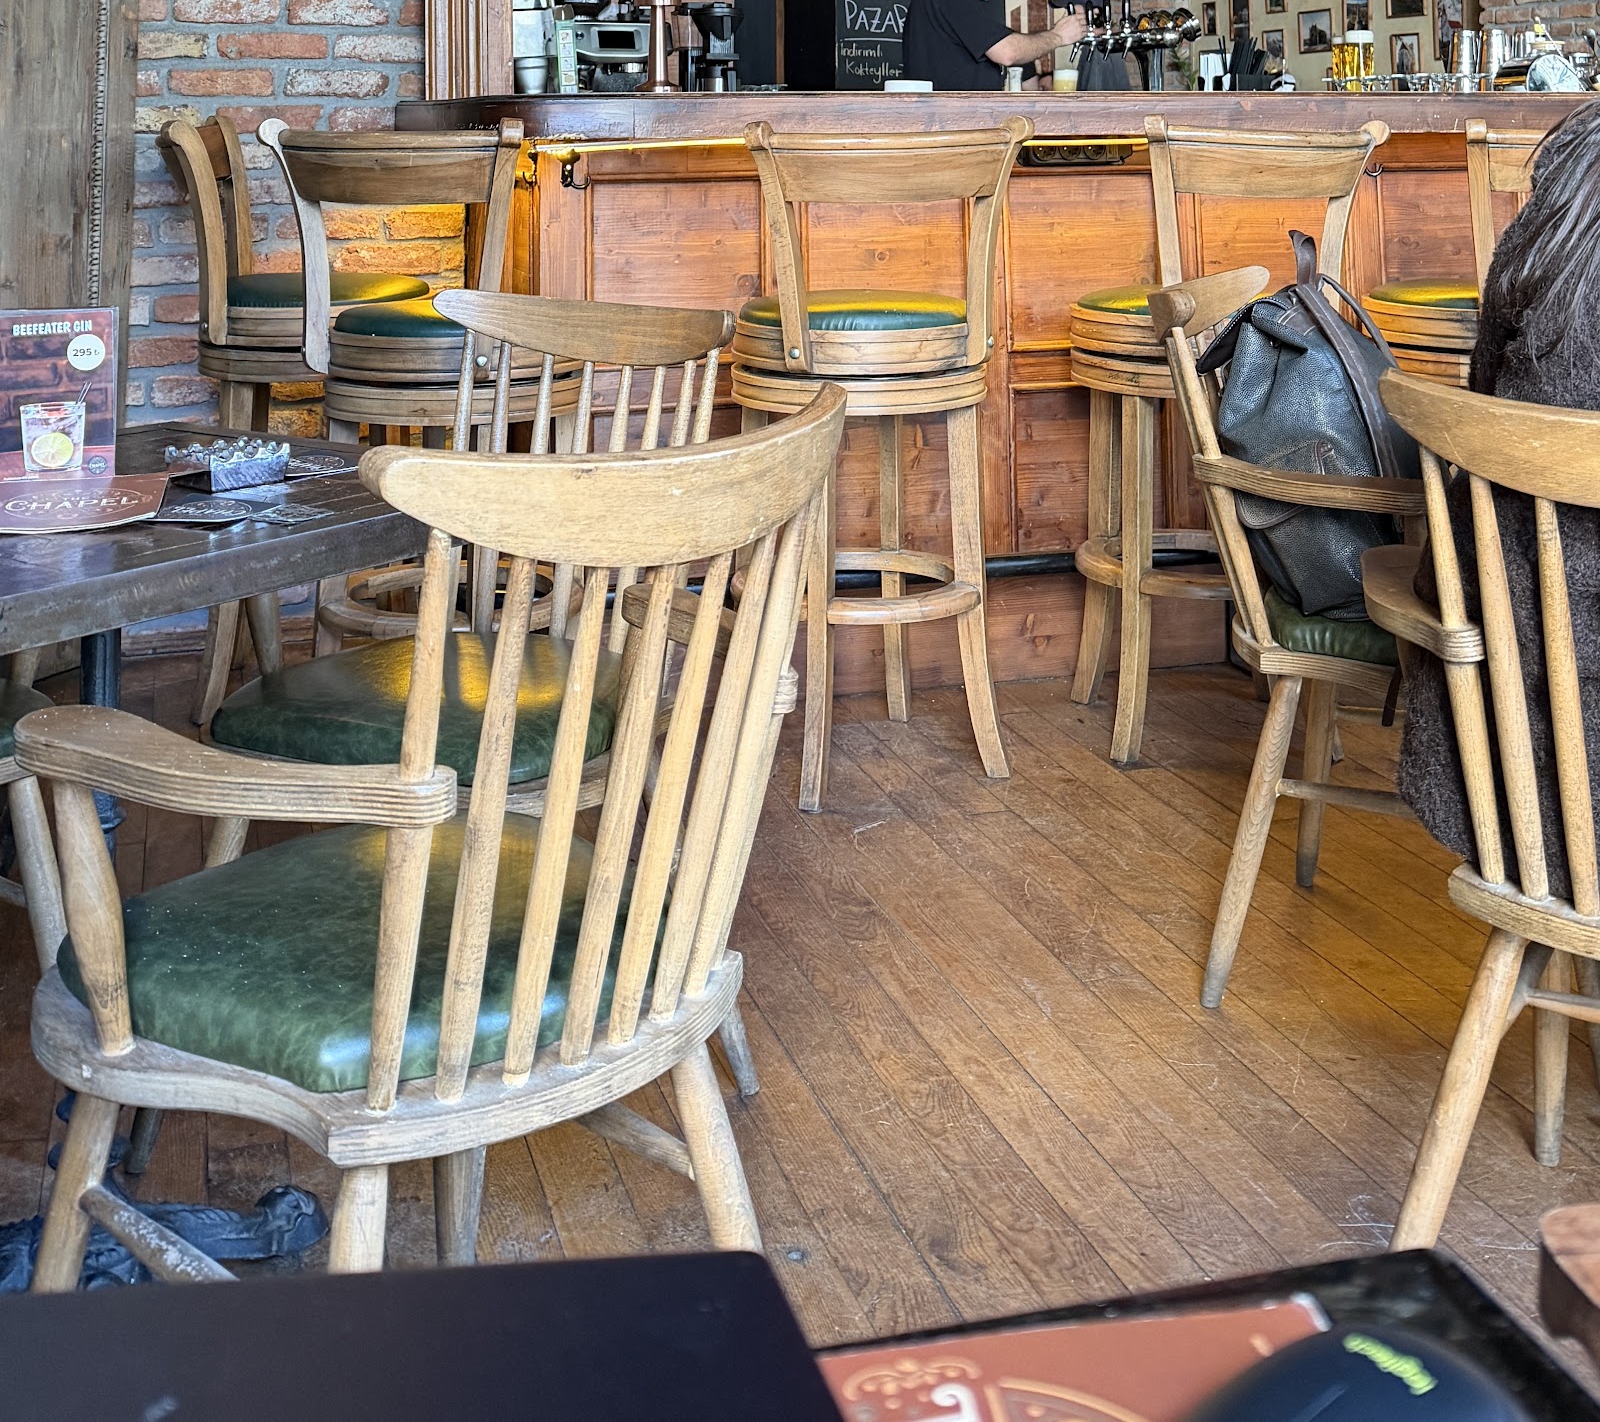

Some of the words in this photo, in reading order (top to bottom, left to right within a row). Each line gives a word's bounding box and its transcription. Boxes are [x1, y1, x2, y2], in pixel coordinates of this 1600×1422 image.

[13, 321, 71, 336] BEEFEATER
[73, 320, 92, 332] GIN
[72, 348, 92, 357] 295
[5, 496, 139, 512] CHAPEL
